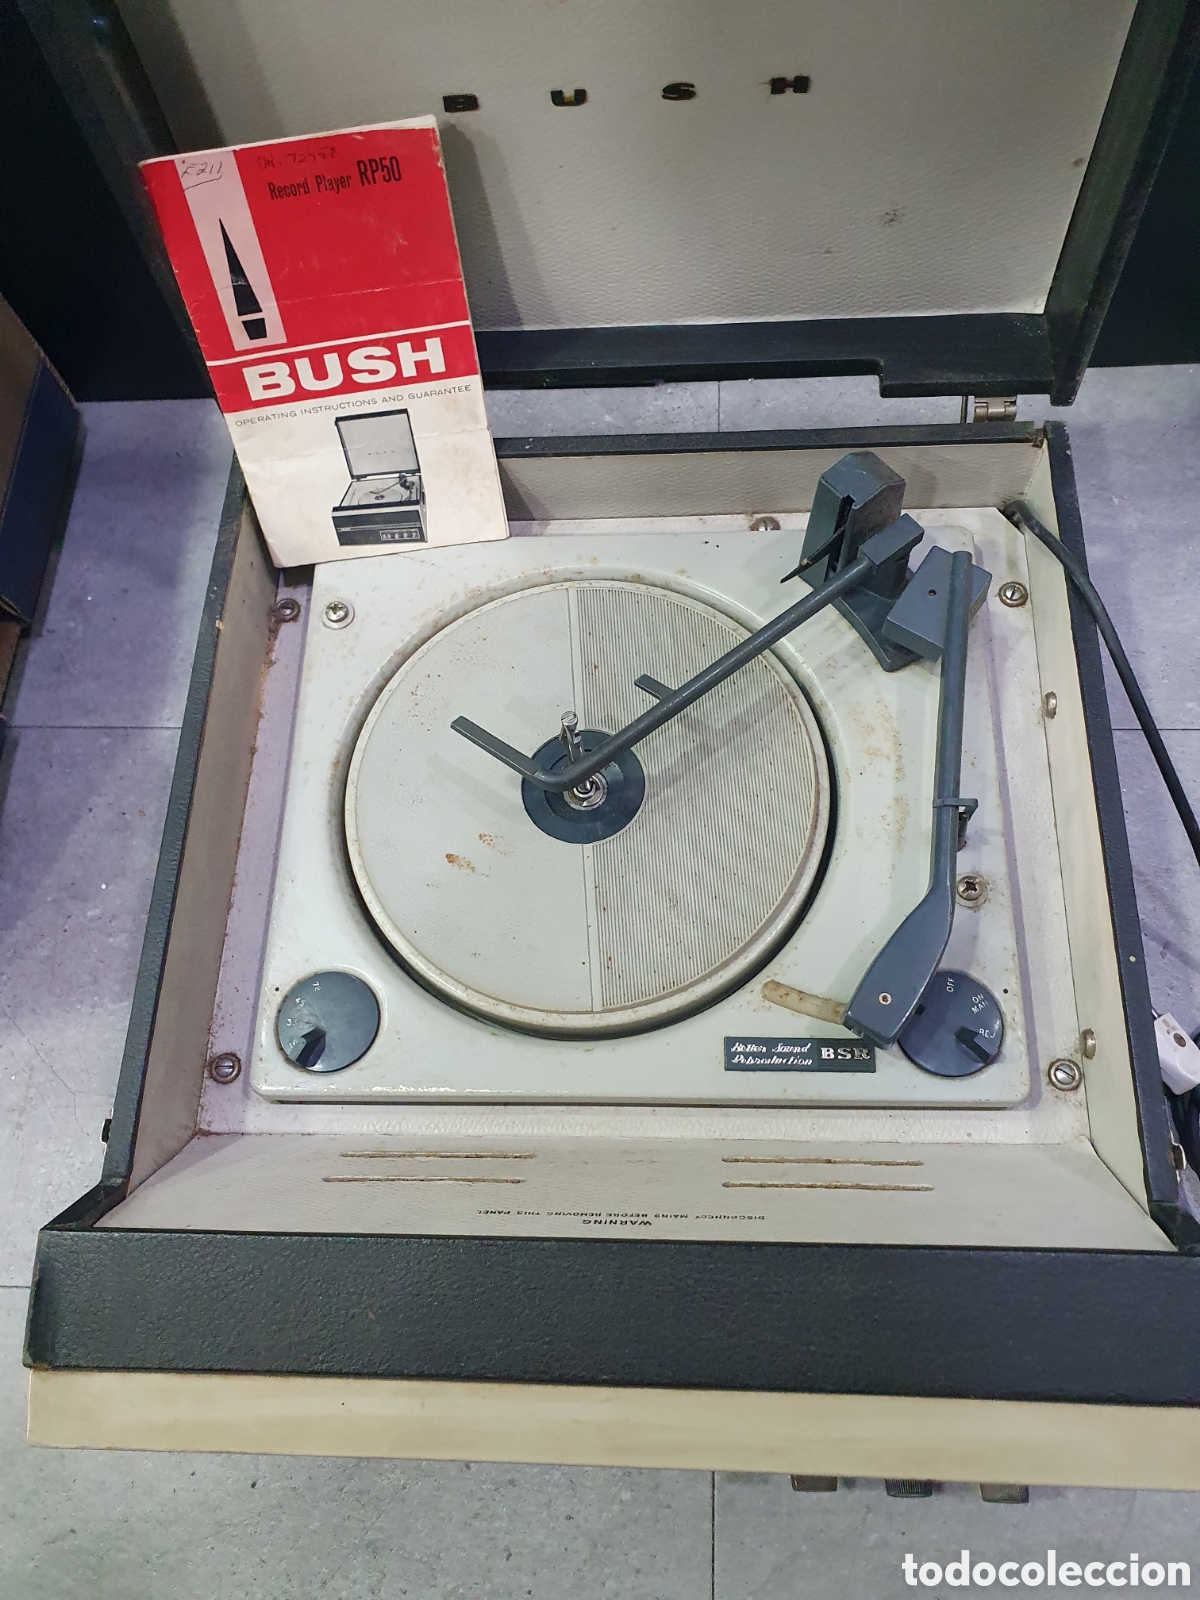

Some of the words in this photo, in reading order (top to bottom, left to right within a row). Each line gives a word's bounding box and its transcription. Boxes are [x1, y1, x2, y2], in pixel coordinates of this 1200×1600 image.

[267, 177, 310, 201] Record
[314, 173, 353, 197] Player
[356, 156, 403, 188] RP50
[242, 337, 447, 402] BUSH
[234, 410, 298, 428] OPERATING
[300, 397, 379, 416] INSTRUCTIONS
[381, 393, 404, 404] AND
[407, 384, 472, 401] GUARANTEE
[946, 977, 955, 993] OFF
[972, 993, 985, 1004] ON
[979, 1028, 996, 1039] REJ
[772, 1042, 812, 1053] Sound
[820, 1046, 871, 1061] BSR
[582, 1218, 653, 1226] WARNING
